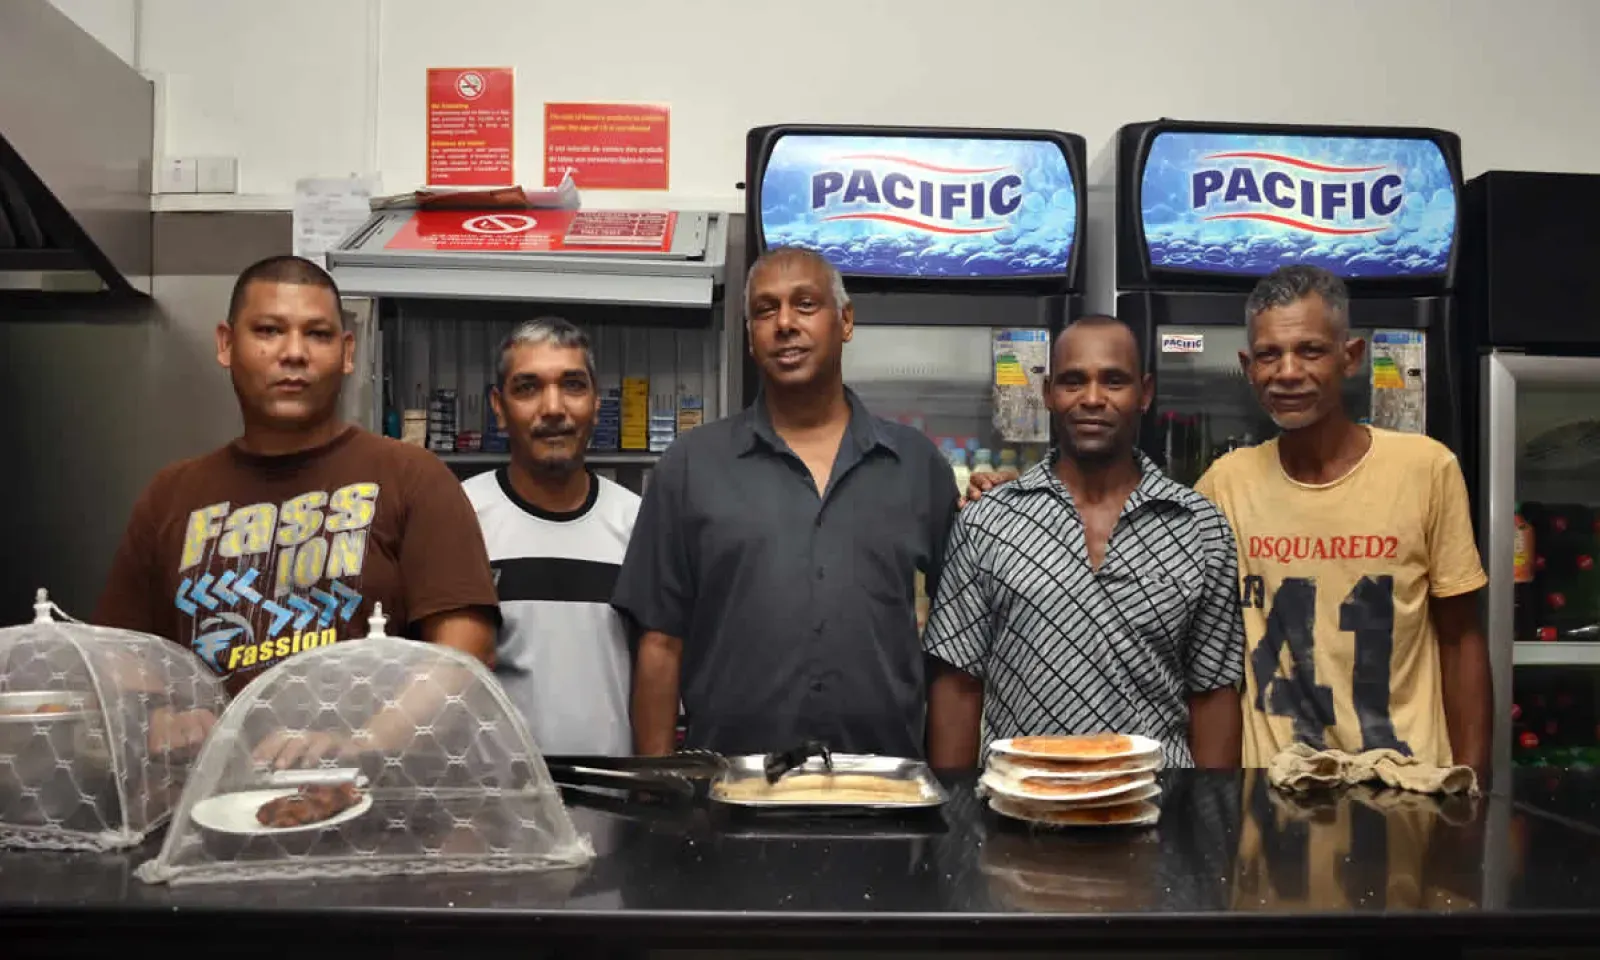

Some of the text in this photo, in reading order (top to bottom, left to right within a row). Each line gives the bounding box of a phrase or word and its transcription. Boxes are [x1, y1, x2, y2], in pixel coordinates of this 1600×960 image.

[812, 169, 1022, 220] PACIFIC
[1193, 167, 1402, 220] PACIFIC
[1164, 338, 1202, 348] PACIFIC
[1249, 535, 1398, 563] DSQUARED2
[228, 627, 338, 669] Fassion
[1251, 575, 1413, 756] 41
